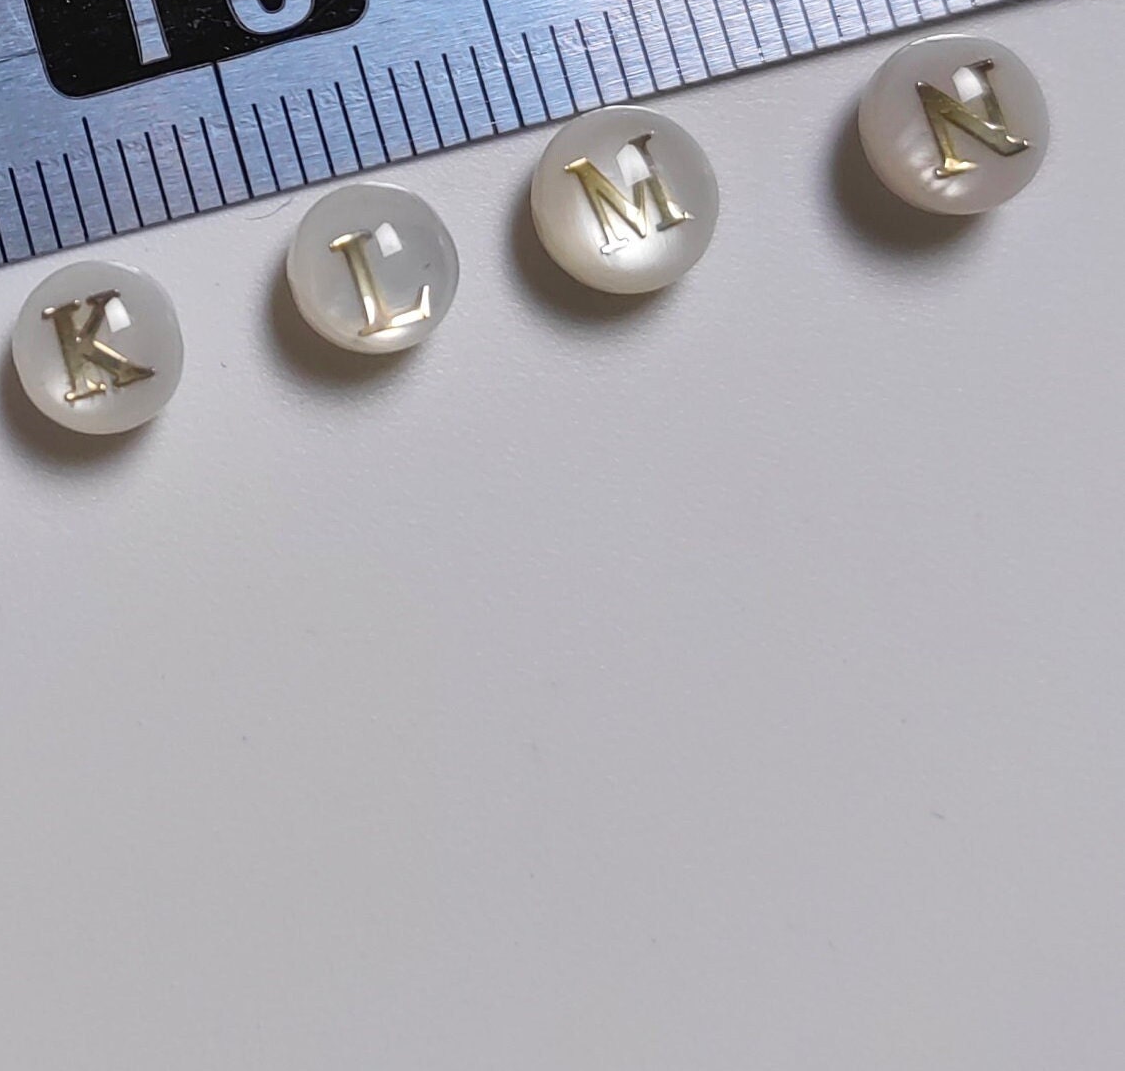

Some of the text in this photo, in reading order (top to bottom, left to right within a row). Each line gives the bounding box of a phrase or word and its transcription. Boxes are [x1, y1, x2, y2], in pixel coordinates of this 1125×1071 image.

[914, 58, 1031, 179] N
[564, 130, 695, 254] M
[328, 229, 430, 336] L
[42, 288, 155, 405] K
